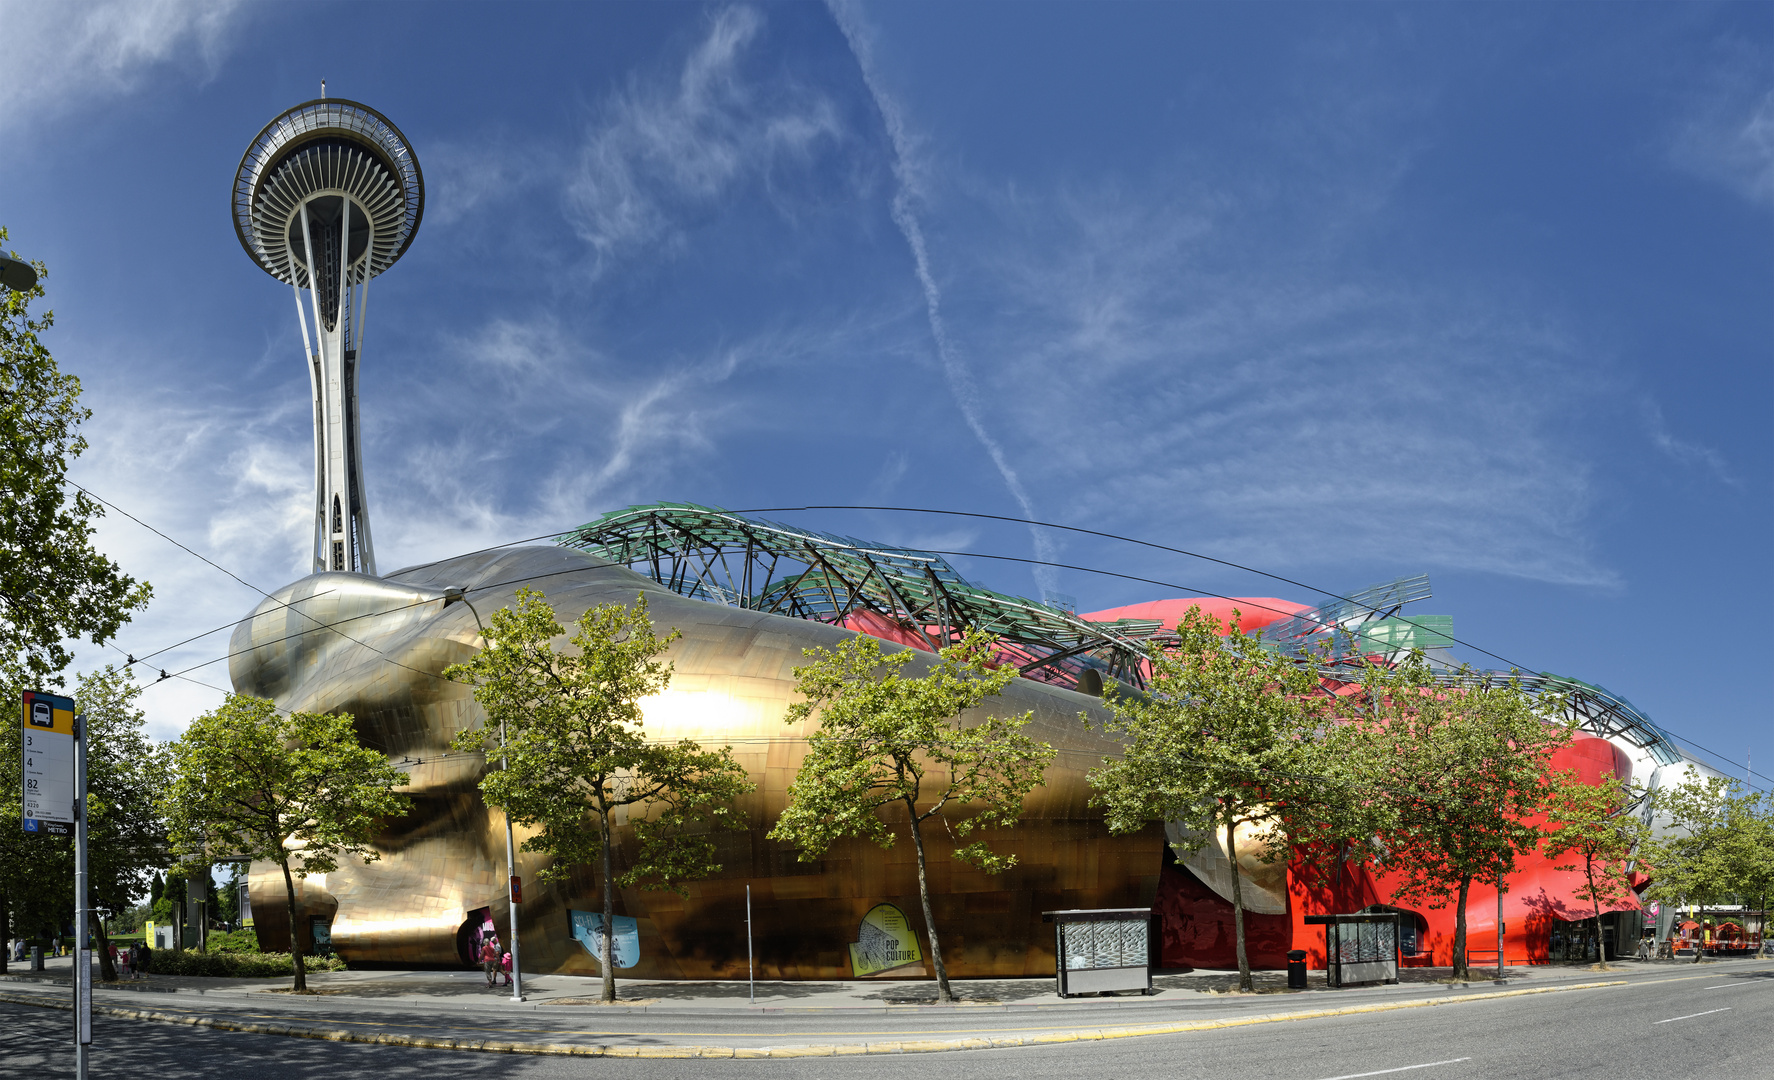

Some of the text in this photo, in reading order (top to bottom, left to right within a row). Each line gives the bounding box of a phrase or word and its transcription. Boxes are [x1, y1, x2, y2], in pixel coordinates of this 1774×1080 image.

[27, 736, 32, 746] 3
[27, 757, 33, 767] 4
[27, 779, 38, 789] 82
[574, 915, 593, 927] SCI-FI
[886, 939, 900, 950] POP
[886, 950, 915, 961] CULTURE
